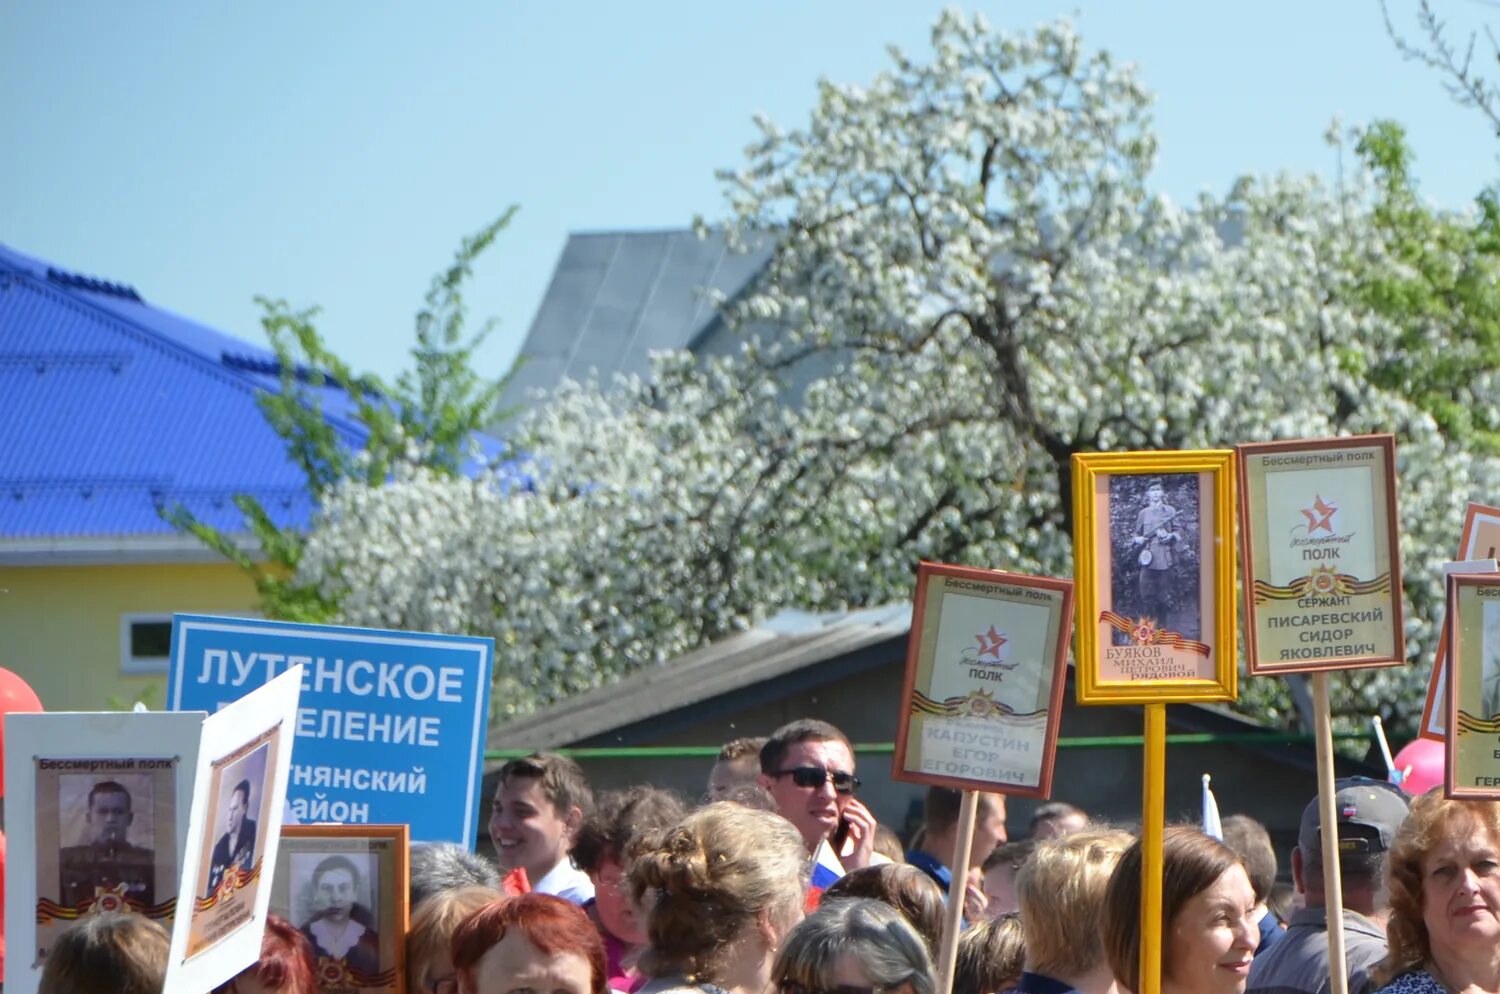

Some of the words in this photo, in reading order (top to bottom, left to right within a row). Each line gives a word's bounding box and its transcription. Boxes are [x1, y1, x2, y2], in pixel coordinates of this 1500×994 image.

[1262, 453, 1344, 467] Бессмертный
[1346, 452, 1375, 462] полк
[1302, 548, 1341, 561] ПОЛК
[944, 577, 1023, 597] Бессмертный
[1297, 595, 1352, 609] СЕРЖАНТ
[1267, 607, 1384, 628] ПИСАРЕВСКИЙ
[1299, 629, 1354, 643] СИДОР
[1105, 646, 1162, 660] БУЯКОВ
[1280, 643, 1376, 660] ЯКОВЛЕВИЧ
[1113, 657, 1174, 667] МИХАИЛ
[1120, 664, 1185, 674] ПЕТРОВИЧ
[197, 648, 465, 703] ЛУТЕНСКОЕ
[968, 668, 1004, 682] ПОЛК
[926, 727, 1031, 752] КАПУСТИН
[951, 747, 1000, 763] ЕГОР
[39, 758, 135, 771] Бессмертный
[138, 760, 173, 770] полк
[922, 759, 1025, 783] ЕГОРОВИЧ
[288, 763, 427, 794] нянский
[284, 793, 370, 823] айон
